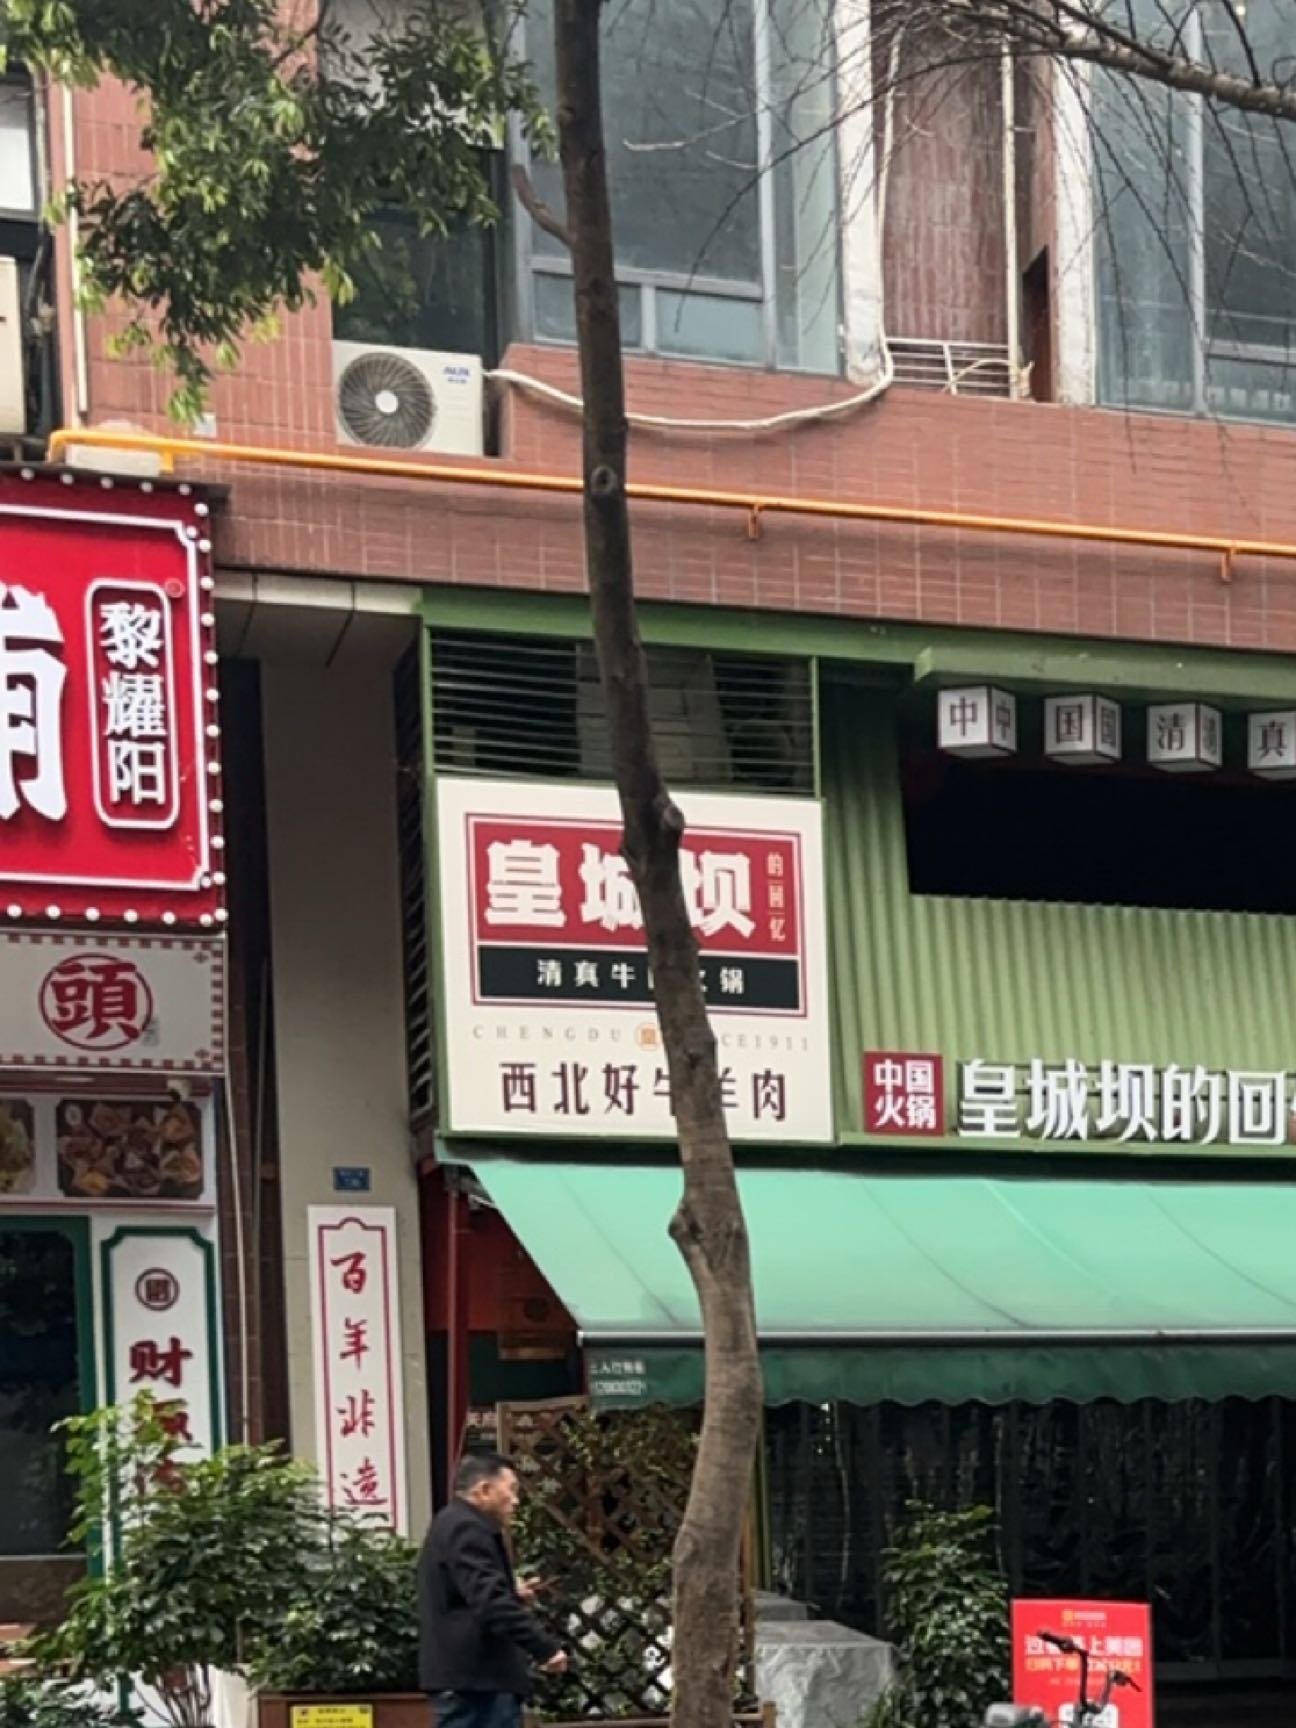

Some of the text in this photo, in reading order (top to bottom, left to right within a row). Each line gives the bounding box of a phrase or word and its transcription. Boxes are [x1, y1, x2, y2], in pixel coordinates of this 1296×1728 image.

[100, 601, 166, 804] 黎耀阳
[537, 958, 744, 996] 清真牛锅
[49, 961, 140, 1040] 頭
[873, 1058, 935, 1095] 中国
[873, 1095, 937, 1130] 火锅
